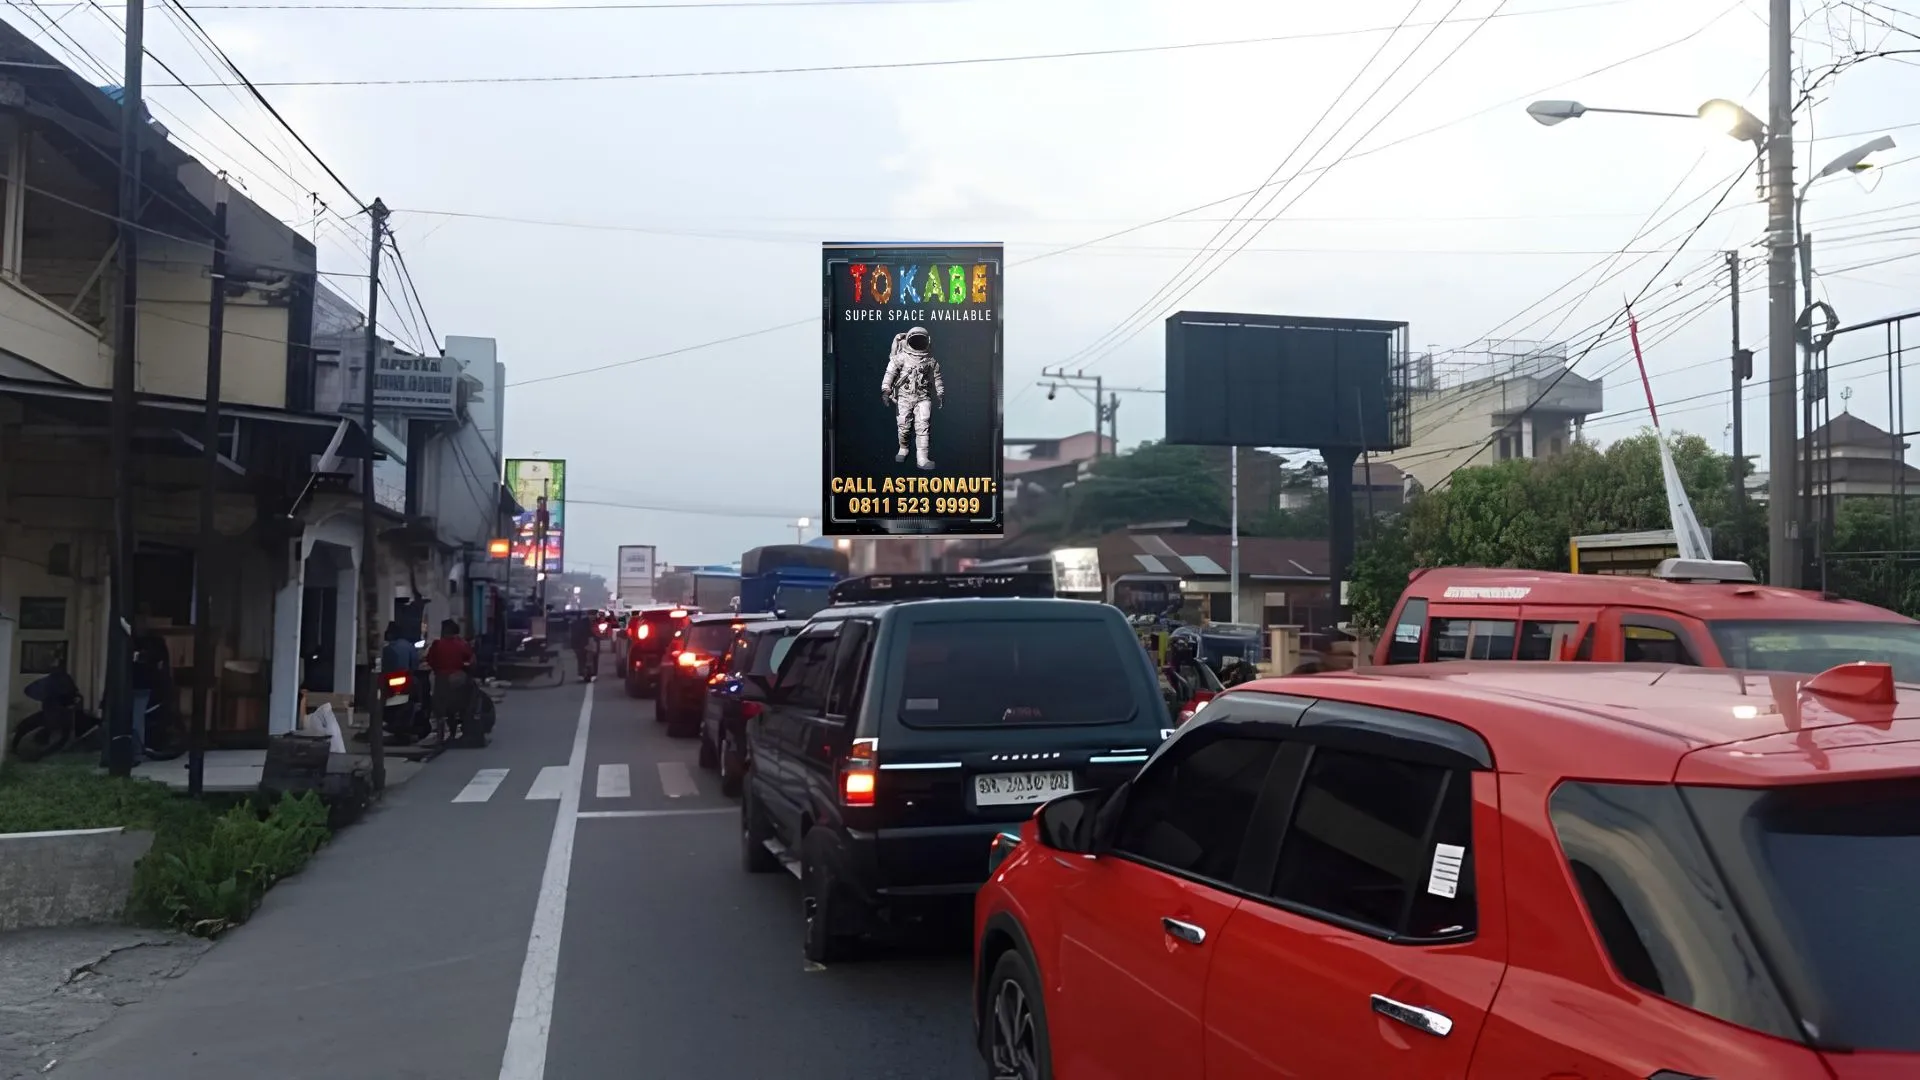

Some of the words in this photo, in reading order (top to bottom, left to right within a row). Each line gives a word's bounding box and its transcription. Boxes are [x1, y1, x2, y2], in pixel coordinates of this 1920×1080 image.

[850, 263, 987, 305] TOKABE
[845, 310, 882, 321] SUPER
[888, 310, 925, 321] SPACE
[930, 310, 992, 321] AVAILABLE
[831, 477, 876, 493] CALL
[882, 477, 997, 494] ASTRONAUT:
[848, 497, 890, 514] 0811
[897, 497, 930, 514] 523
[935, 497, 980, 514] 9999
